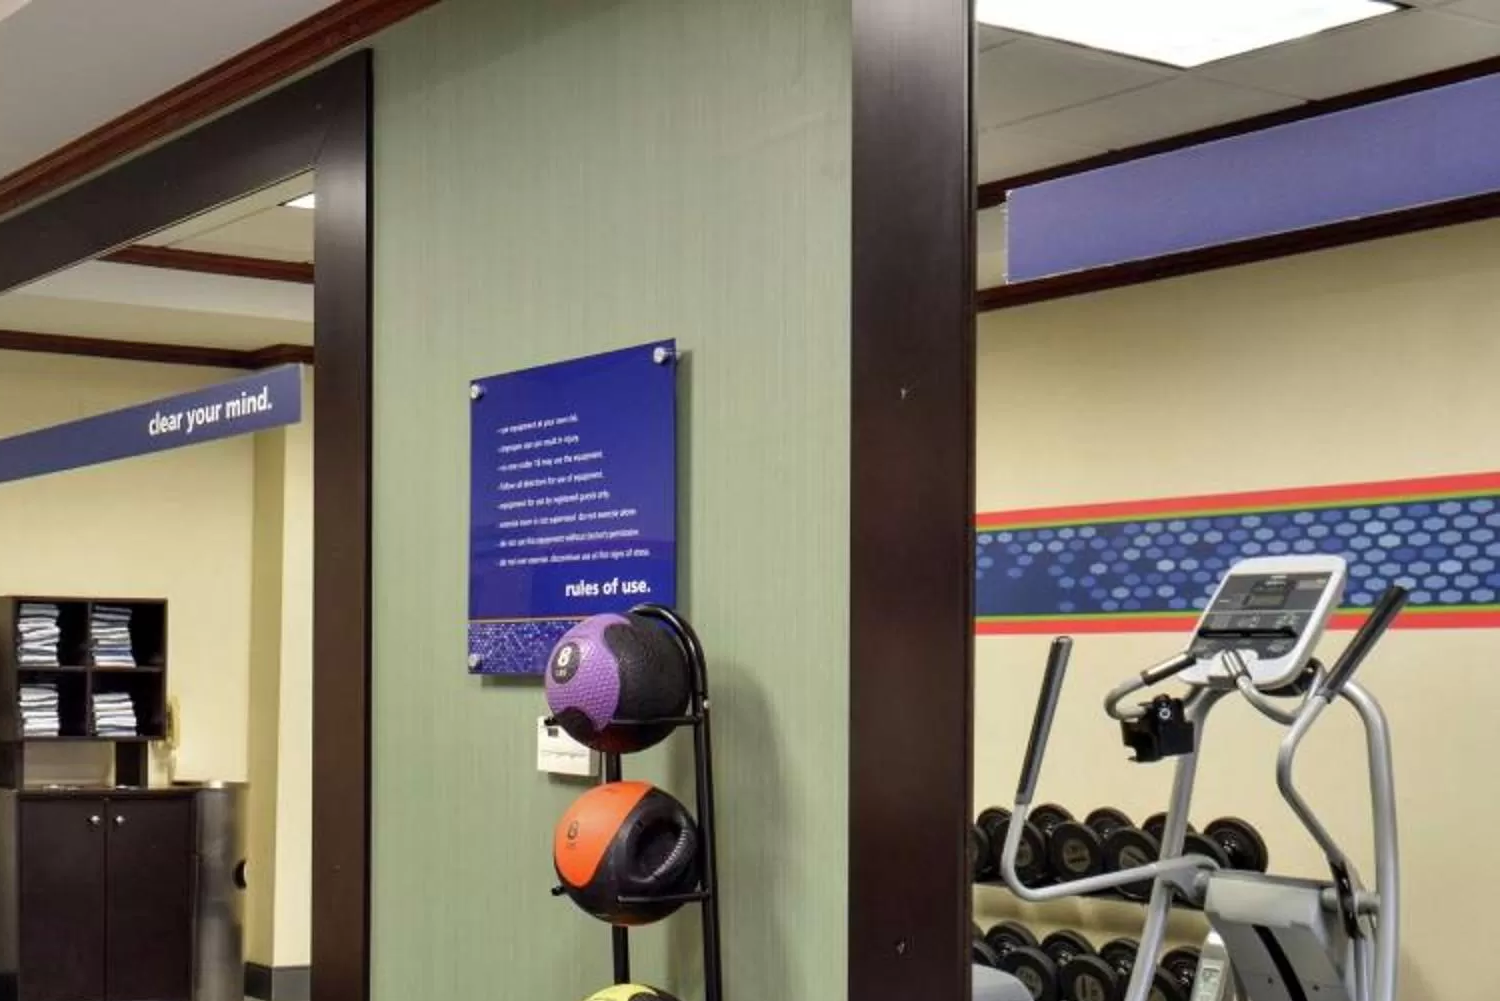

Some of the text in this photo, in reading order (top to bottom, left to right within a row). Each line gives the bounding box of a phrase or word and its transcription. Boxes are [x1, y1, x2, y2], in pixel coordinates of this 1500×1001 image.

[148, 385, 273, 436] clear your mind.
[565, 577, 651, 597] rules of use.
[557, 645, 573, 667] 8
